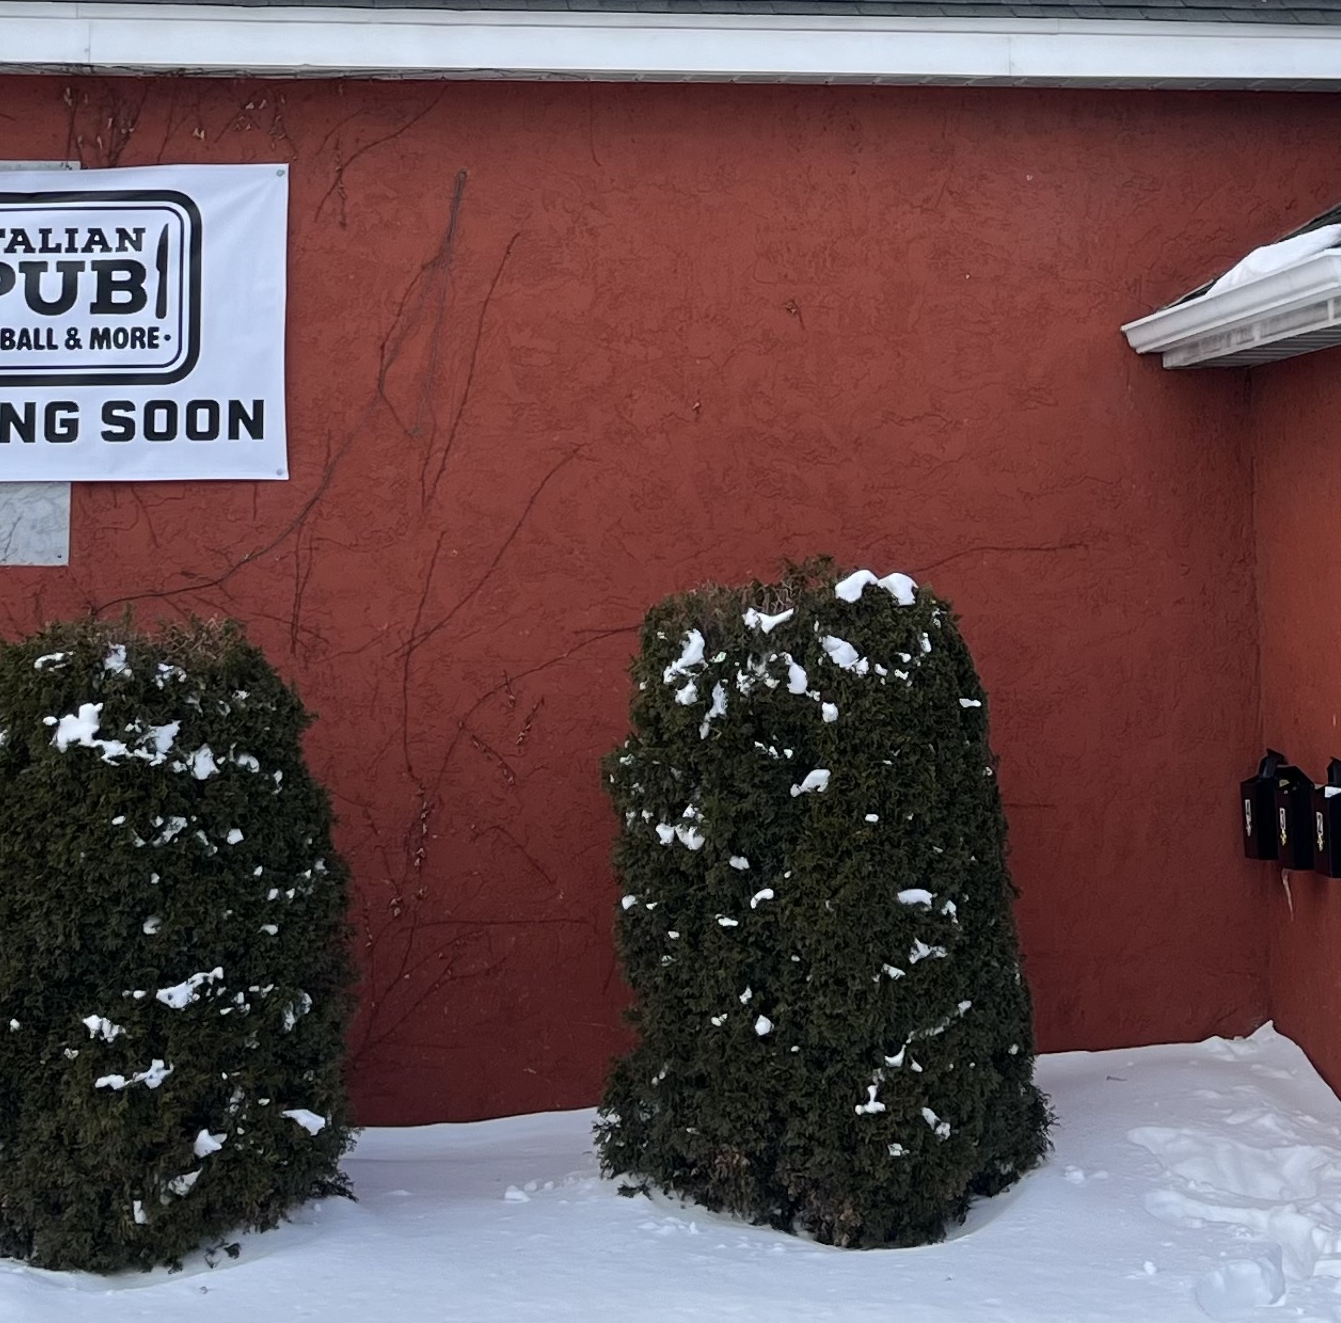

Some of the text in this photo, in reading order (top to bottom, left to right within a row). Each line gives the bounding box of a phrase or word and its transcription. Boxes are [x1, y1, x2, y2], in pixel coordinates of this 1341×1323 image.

[64, 328, 83, 351] &
[89, 326, 160, 350] MORE
[101, 399, 265, 443] SOON
